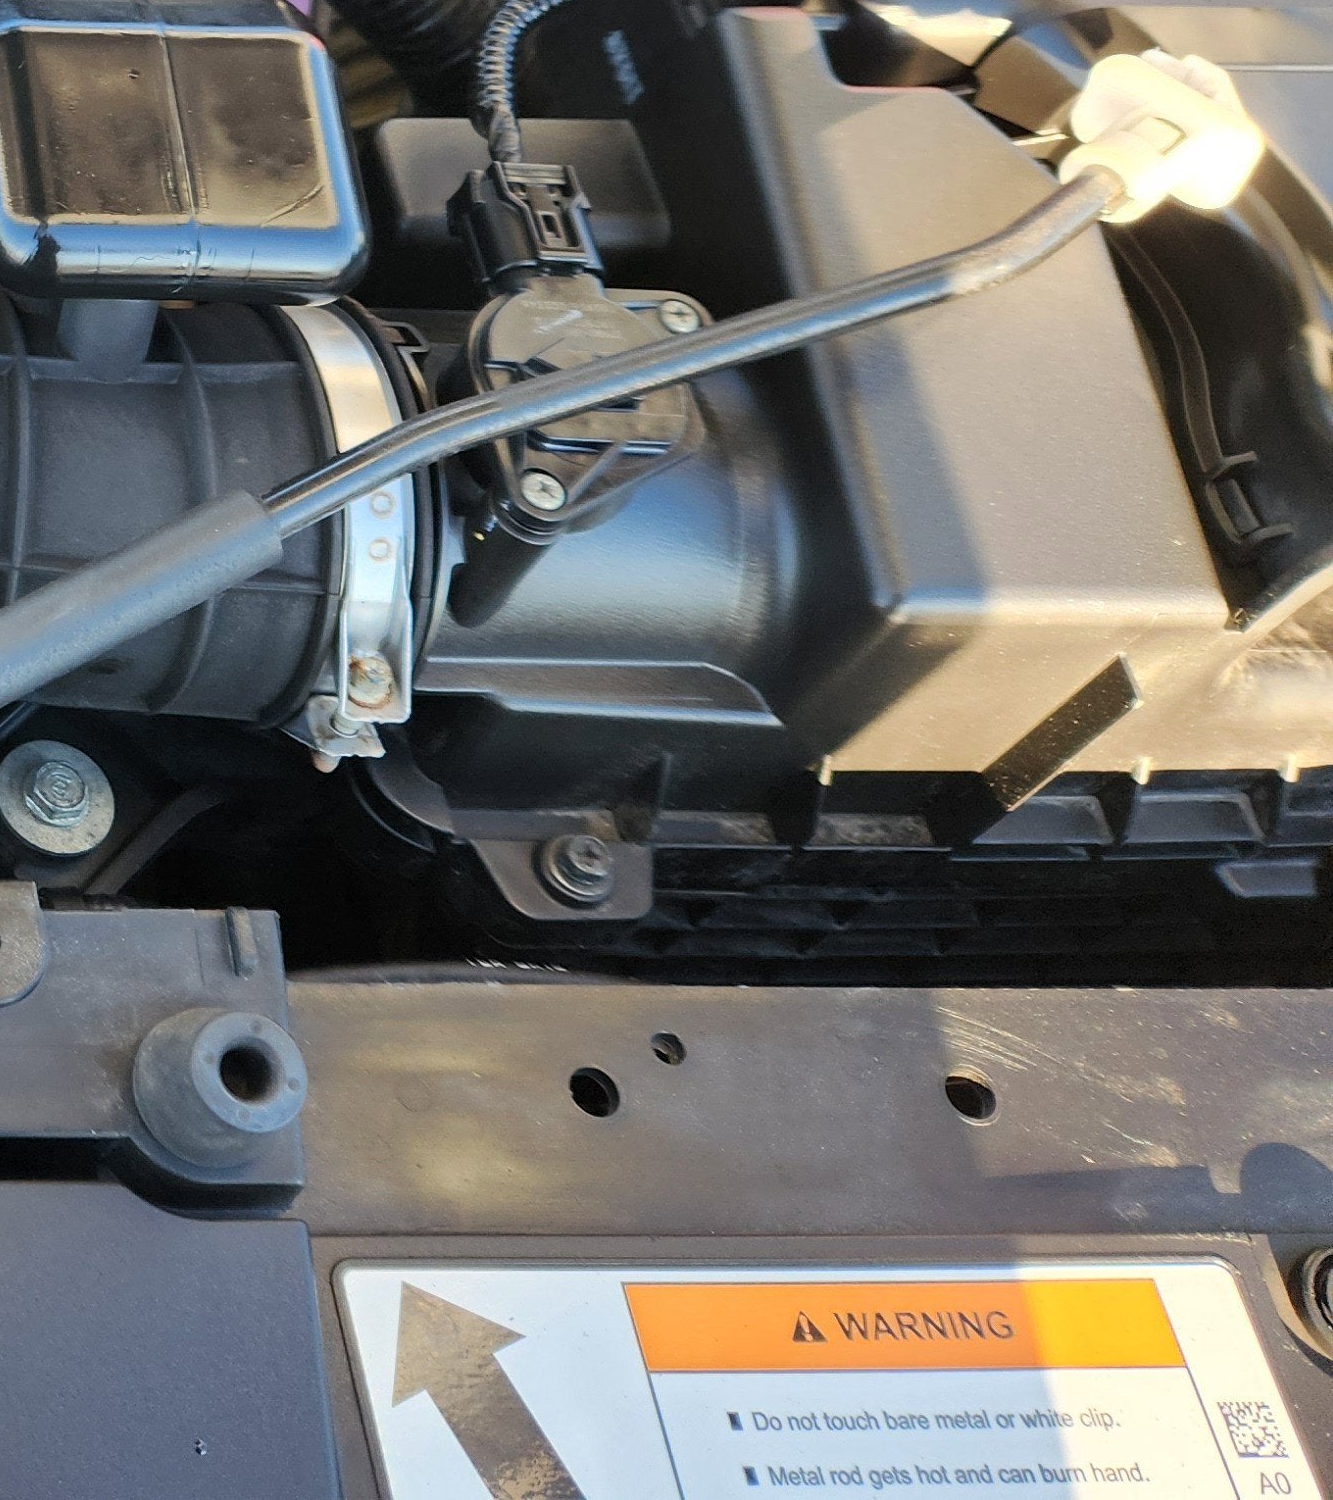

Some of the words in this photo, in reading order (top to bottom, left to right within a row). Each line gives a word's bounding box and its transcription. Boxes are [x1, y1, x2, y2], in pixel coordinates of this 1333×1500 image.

[833, 1310, 1015, 1341] WARNING
[751, 1411, 782, 1431] Do
[788, 1412, 819, 1431] not
[822, 1410, 880, 1430] touch
[882, 1410, 930, 1430] bare
[935, 1409, 990, 1430] metal
[996, 1413, 1015, 1428] or
[1020, 1409, 1074, 1429] white
[1080, 1408, 1121, 1432] clip.
[767, 1465, 824, 1486] Metal
[829, 1465, 861, 1486] rod
[868, 1467, 913, 1490] gets
[915, 1465, 950, 1485] hot
[955, 1465, 994, 1485] and
[998, 1467, 1036, 1484] can
[1040, 1464, 1087, 1484] burn
[1090, 1463, 1150, 1483] hand.
[1259, 1471, 1292, 1496] A0
